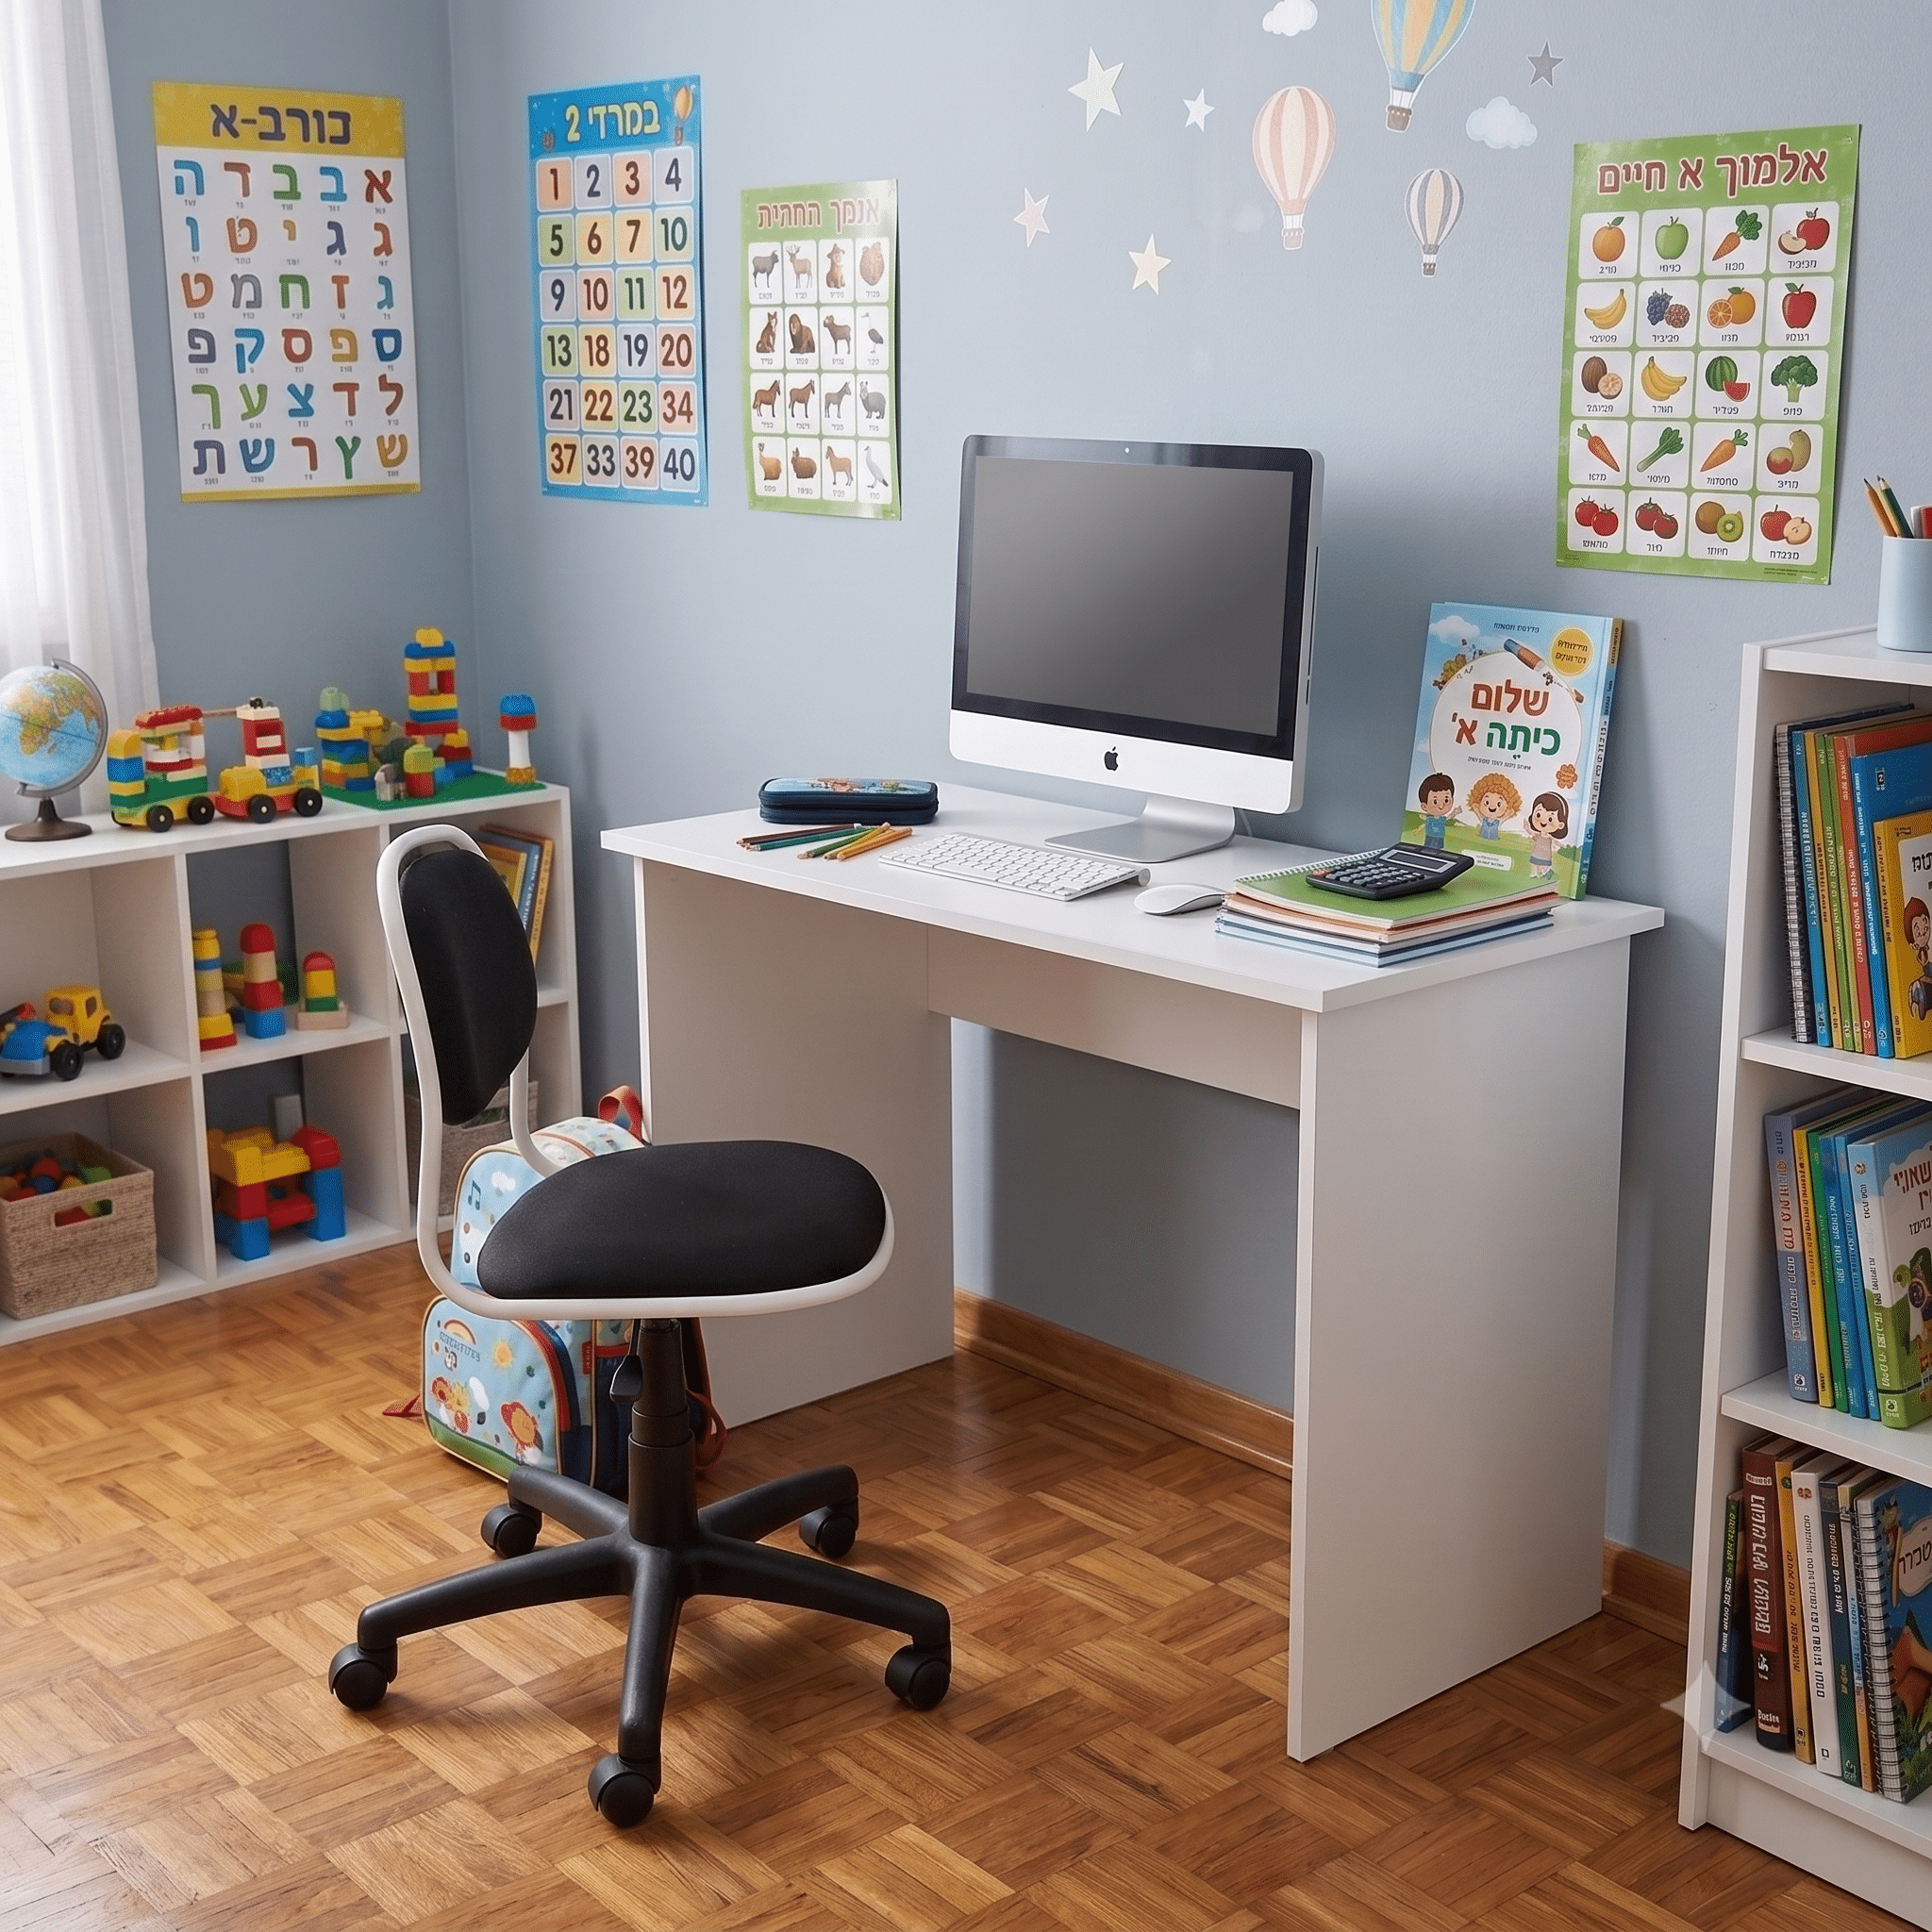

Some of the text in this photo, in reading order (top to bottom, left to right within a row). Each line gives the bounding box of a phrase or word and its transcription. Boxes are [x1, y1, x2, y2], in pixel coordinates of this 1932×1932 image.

[566, 106, 579, 141] 2
[174, 160, 205, 195] ה
[273, 164, 301, 200] ב
[320, 166, 347, 202] ב
[364, 170, 392, 203] א
[550, 158, 681, 200] 1 2 3 4
[1598, 160, 1667, 194] חיים
[1678, 158, 1703, 190] א
[186, 217, 392, 257] ג ג י ט ו
[550, 217, 687, 257] 5 6 7 10
[181, 273, 213, 308] ט
[231, 274, 262, 308] מ
[279, 275, 309, 308] ח
[551, 275, 687, 311] 9 10 11 12
[188, 328, 402, 374] ס פ ס ק פ
[547, 334, 691, 367] 13 18 19 20
[240, 384, 268, 421] ע
[287, 383, 314, 417] צ
[378, 374, 403, 416] ל
[550, 389, 693, 423] 21 22 23 34
[193, 440, 225, 475] ת
[240, 439, 275, 473] ש
[291, 437, 318, 471] ר
[335, 436, 361, 479] ץ
[376, 434, 408, 468] ש
[551, 442, 695, 481] 37 33 39 40
[1472, 679, 1550, 717] שלום
[1487, 723, 1561, 757] כיתה
